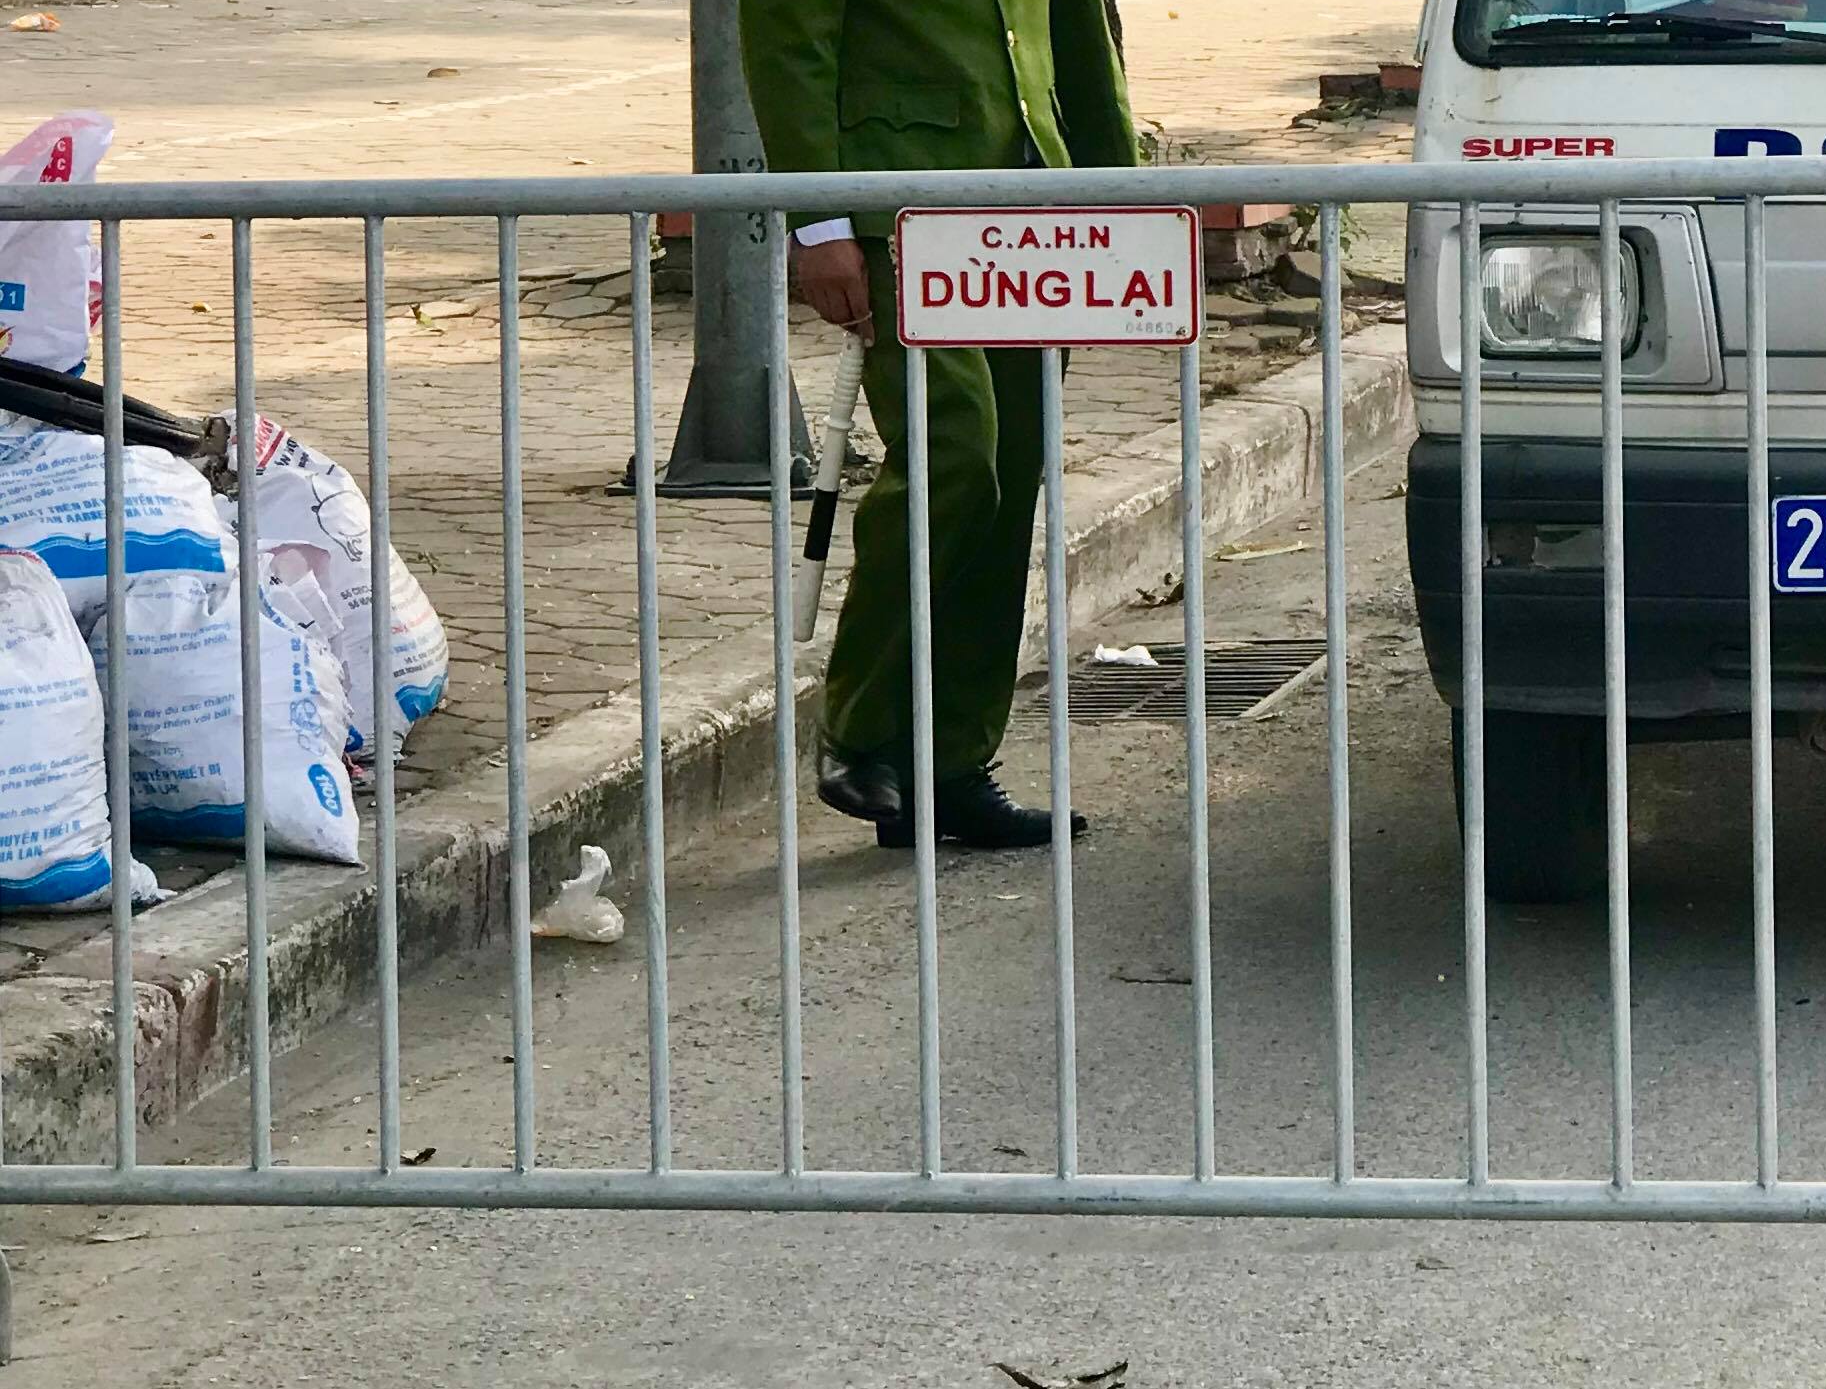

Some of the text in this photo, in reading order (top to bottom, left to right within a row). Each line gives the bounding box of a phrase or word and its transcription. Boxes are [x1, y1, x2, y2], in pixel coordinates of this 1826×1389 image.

[1461, 137, 1615, 158] SUPER
[981, 225, 1110, 249] C.A.H.N
[921, 257, 1174, 318] DỪNG LẠI
